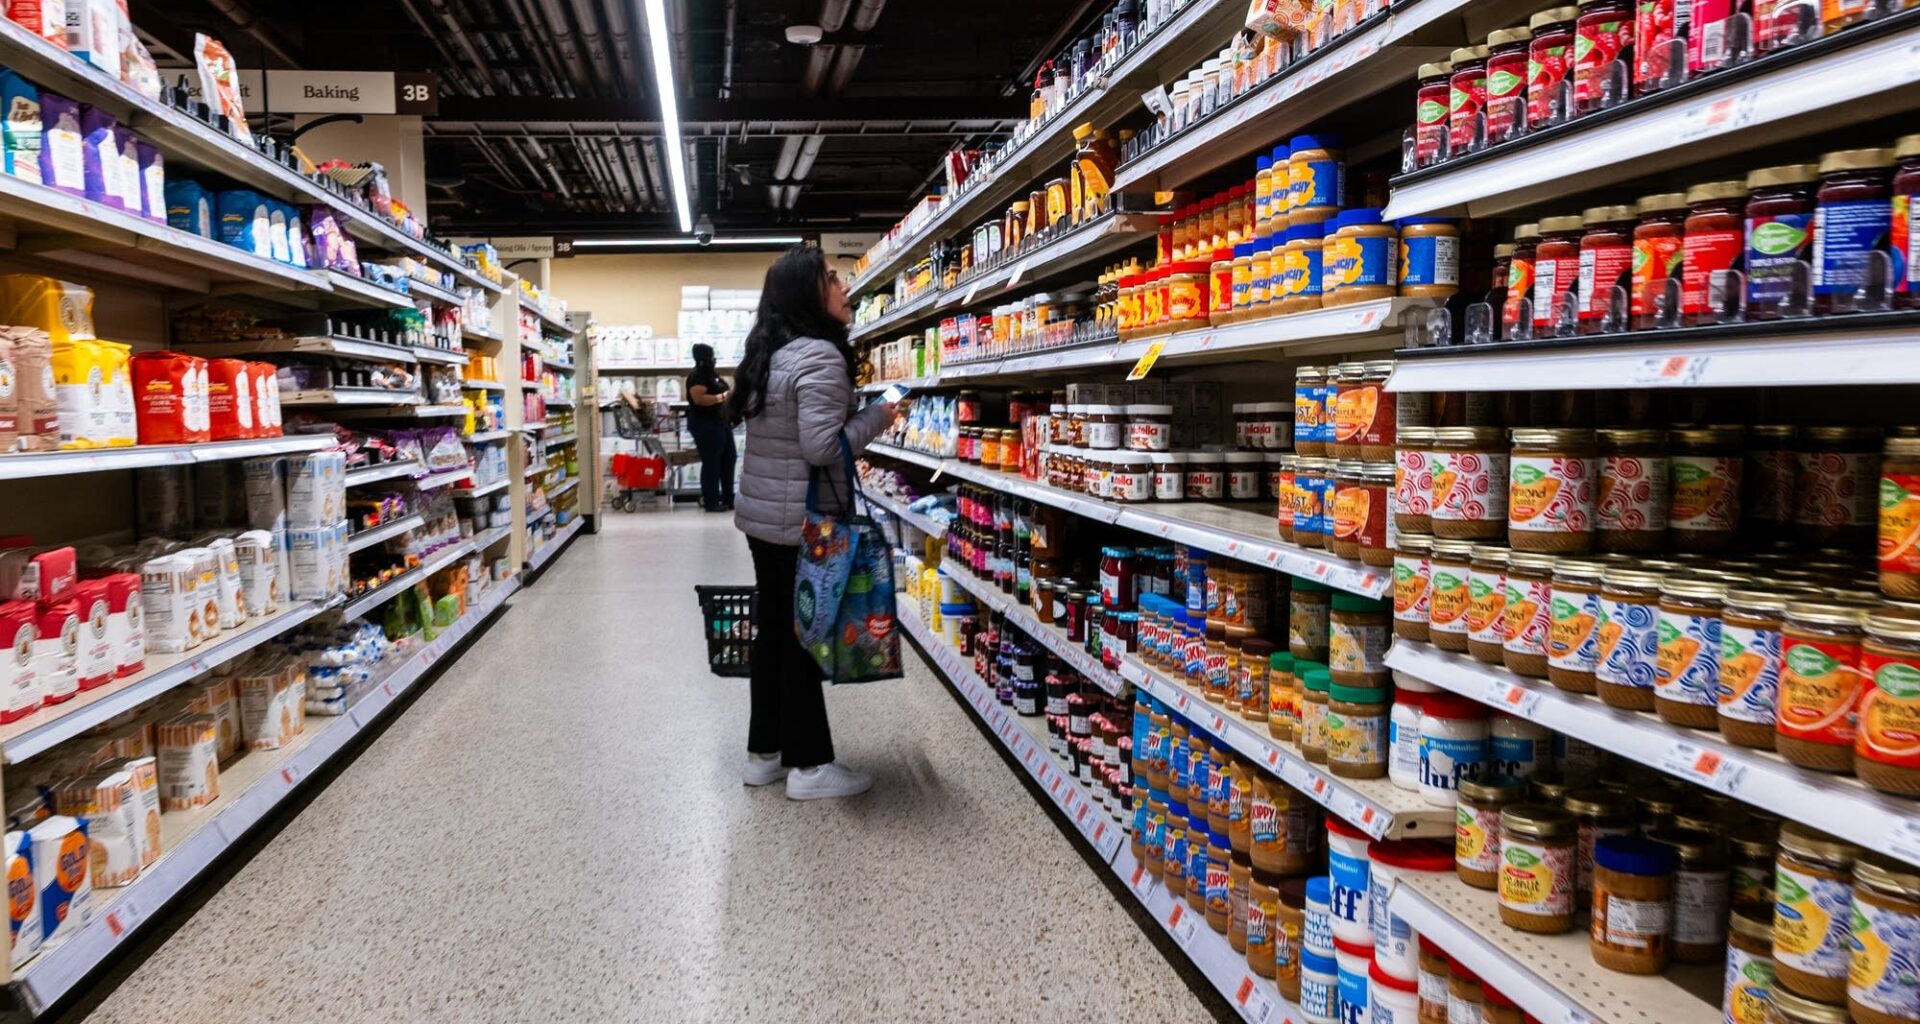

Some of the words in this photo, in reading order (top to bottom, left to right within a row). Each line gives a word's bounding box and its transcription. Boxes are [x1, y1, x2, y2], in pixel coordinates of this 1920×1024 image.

[303, 84, 360, 102] Baking
[402, 85, 430, 101] 3B
[557, 243, 571, 253] 3B
[838, 240, 864, 249] Spices
[1252, 804, 1276, 820] KIPPY
